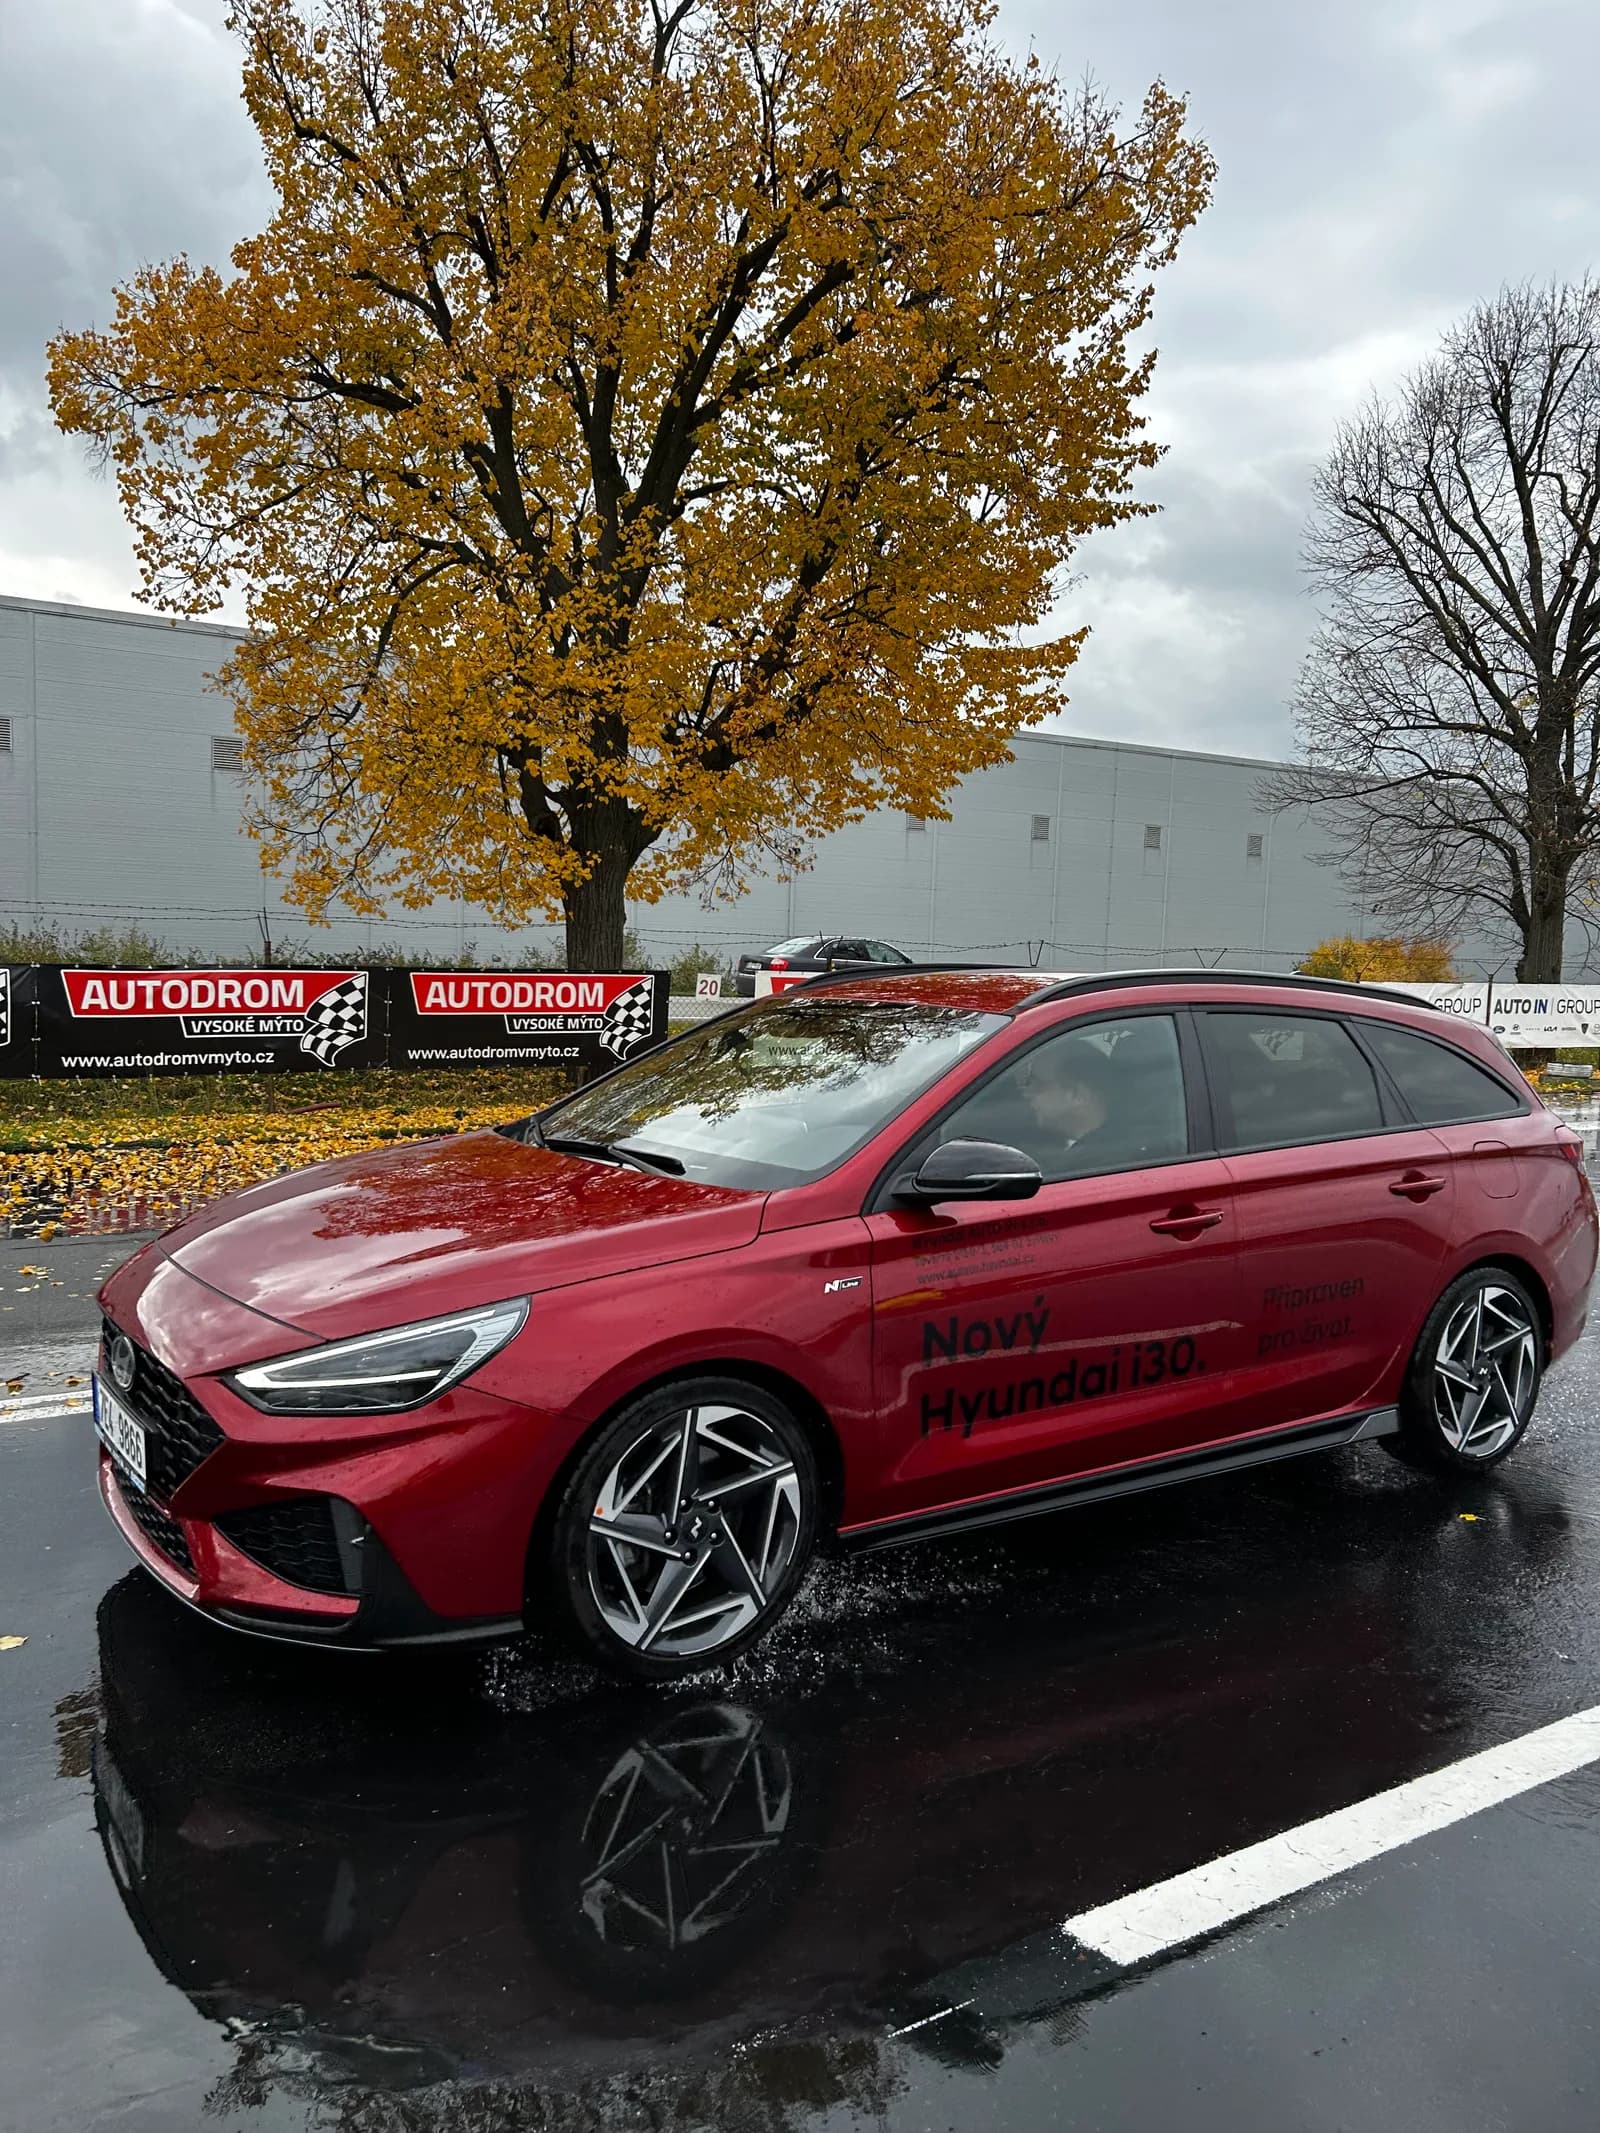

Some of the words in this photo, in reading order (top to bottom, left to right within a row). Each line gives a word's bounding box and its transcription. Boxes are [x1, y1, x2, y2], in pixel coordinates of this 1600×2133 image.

[80, 979, 304, 1010] AUTODROM
[425, 981, 604, 1009] AUTODROM
[699, 979, 719, 996] 20
[1434, 998, 1481, 1014] GROUP
[1494, 998, 1531, 1014] AUTO
[1534, 999, 1549, 1014] IN
[1557, 999, 1600, 1014] GROUP
[190, 1015, 255, 1034] VYSOKÉ
[259, 1015, 304, 1033] MÝTO
[512, 1015, 564, 1030] VYSOKÉ
[568, 1014, 603, 1029] MÝTO
[61, 1051, 275, 1068] www.autodromvmyto.cz
[407, 1045, 579, 1061] www.autodromvmyto.cz
[921, 1295, 1050, 1367] Nový
[1257, 1329, 1295, 1357] pro
[920, 1350, 1121, 1439] Hyundai
[1131, 1336, 1206, 1387] i30.
[118, 1411, 143, 1469] 9866
